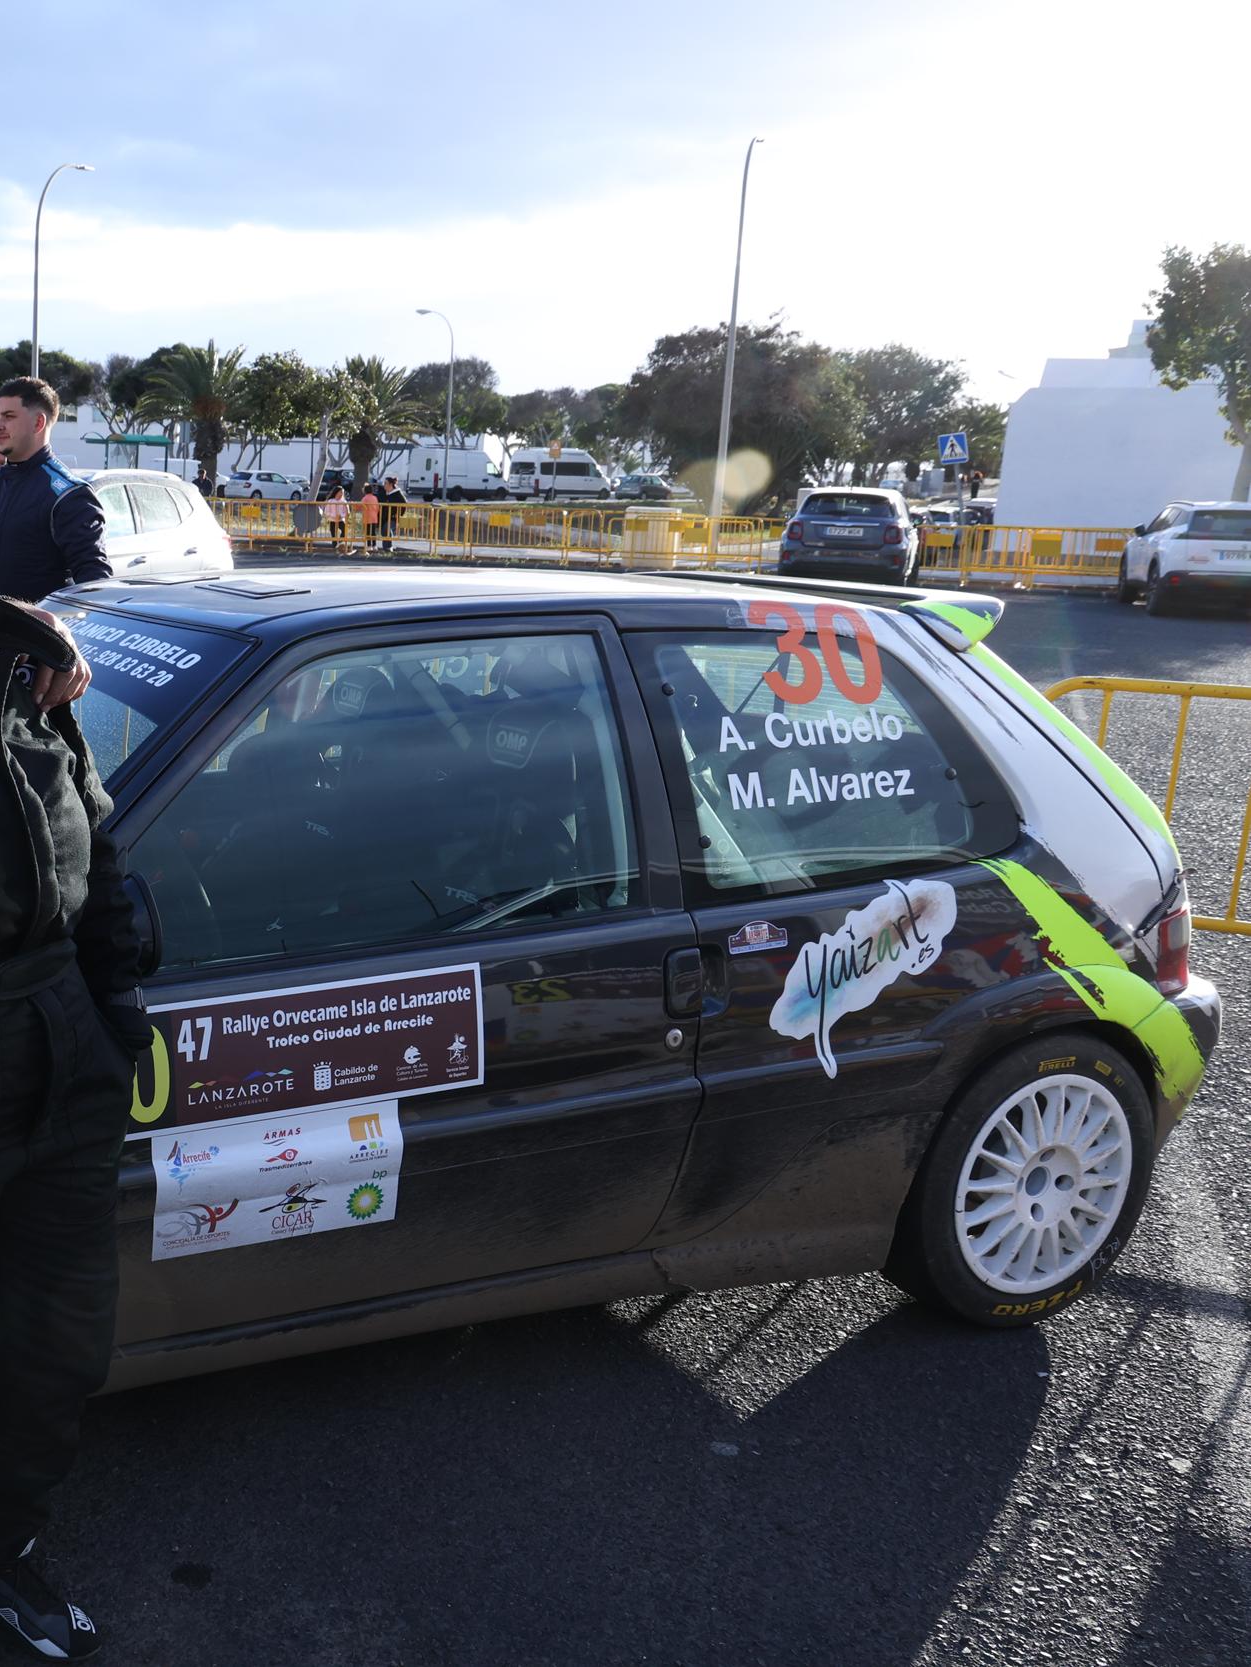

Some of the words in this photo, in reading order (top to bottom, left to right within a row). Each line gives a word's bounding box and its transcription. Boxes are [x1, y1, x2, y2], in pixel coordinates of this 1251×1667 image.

[119, 633, 202, 670] CURBELO
[747, 600, 883, 705] 30
[93, 650, 123, 667] 928
[113, 656, 139, 672] 83
[129, 662, 156, 679] 63
[146, 670, 175, 688] 20
[341, 686, 362, 705] OMP
[718, 715, 756, 753] A.
[764, 708, 903, 749] Curbelo
[495, 731, 528, 752] OMP
[727, 772, 775, 811] M.
[787, 767, 915, 807] Alvarez
[176, 1015, 213, 1063] 47
[222, 1012, 270, 1037] Rallye
[272, 1005, 348, 1026] Orvecame
[350, 998, 377, 1017] Isla
[379, 995, 397, 1012] de
[401, 986, 472, 1010] Lanzarote
[266, 1033, 310, 1049] Trofeo
[312, 1026, 362, 1043] Ciudad
[364, 1021, 381, 1035] de
[383, 1014, 435, 1033] Arrecife
[334, 1066, 366, 1078] Cabildo
[367, 1063, 379, 1072] de
[1038, 1056, 1077, 1073] PIRELLI
[334, 1073, 376, 1087] Lanzarote
[187, 1078, 295, 1106] LANZAROTE
[263, 1127, 301, 1140] ARMAS
[182, 1152, 212, 1165] Arrecife
[349, 1148, 389, 1160] ARRECIFE
[372, 1168, 388, 1181] bp
[271, 1210, 313, 1230] CICAR
